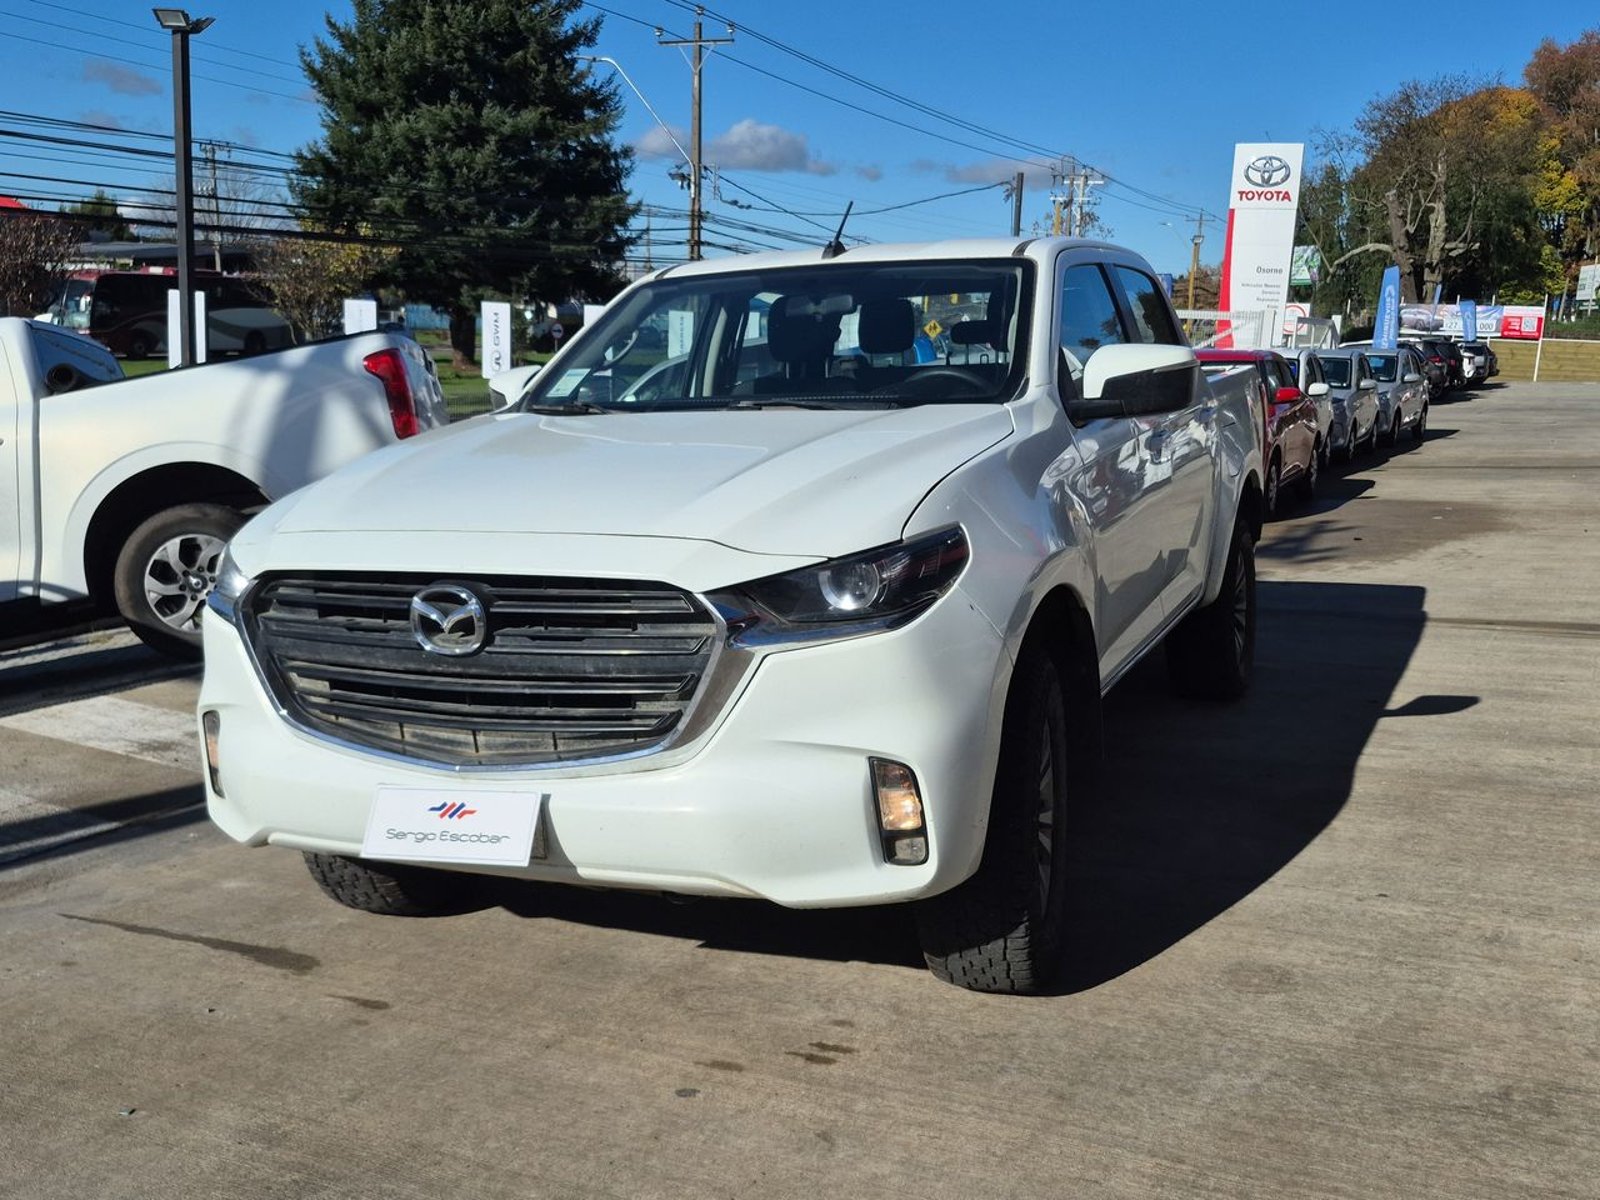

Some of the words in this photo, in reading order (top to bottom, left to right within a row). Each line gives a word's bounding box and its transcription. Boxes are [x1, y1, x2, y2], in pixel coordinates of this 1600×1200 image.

[1237, 191, 1292, 202] TOYOTA
[1256, 266, 1283, 275] Osorno
[439, 830, 511, 844] Escobar
